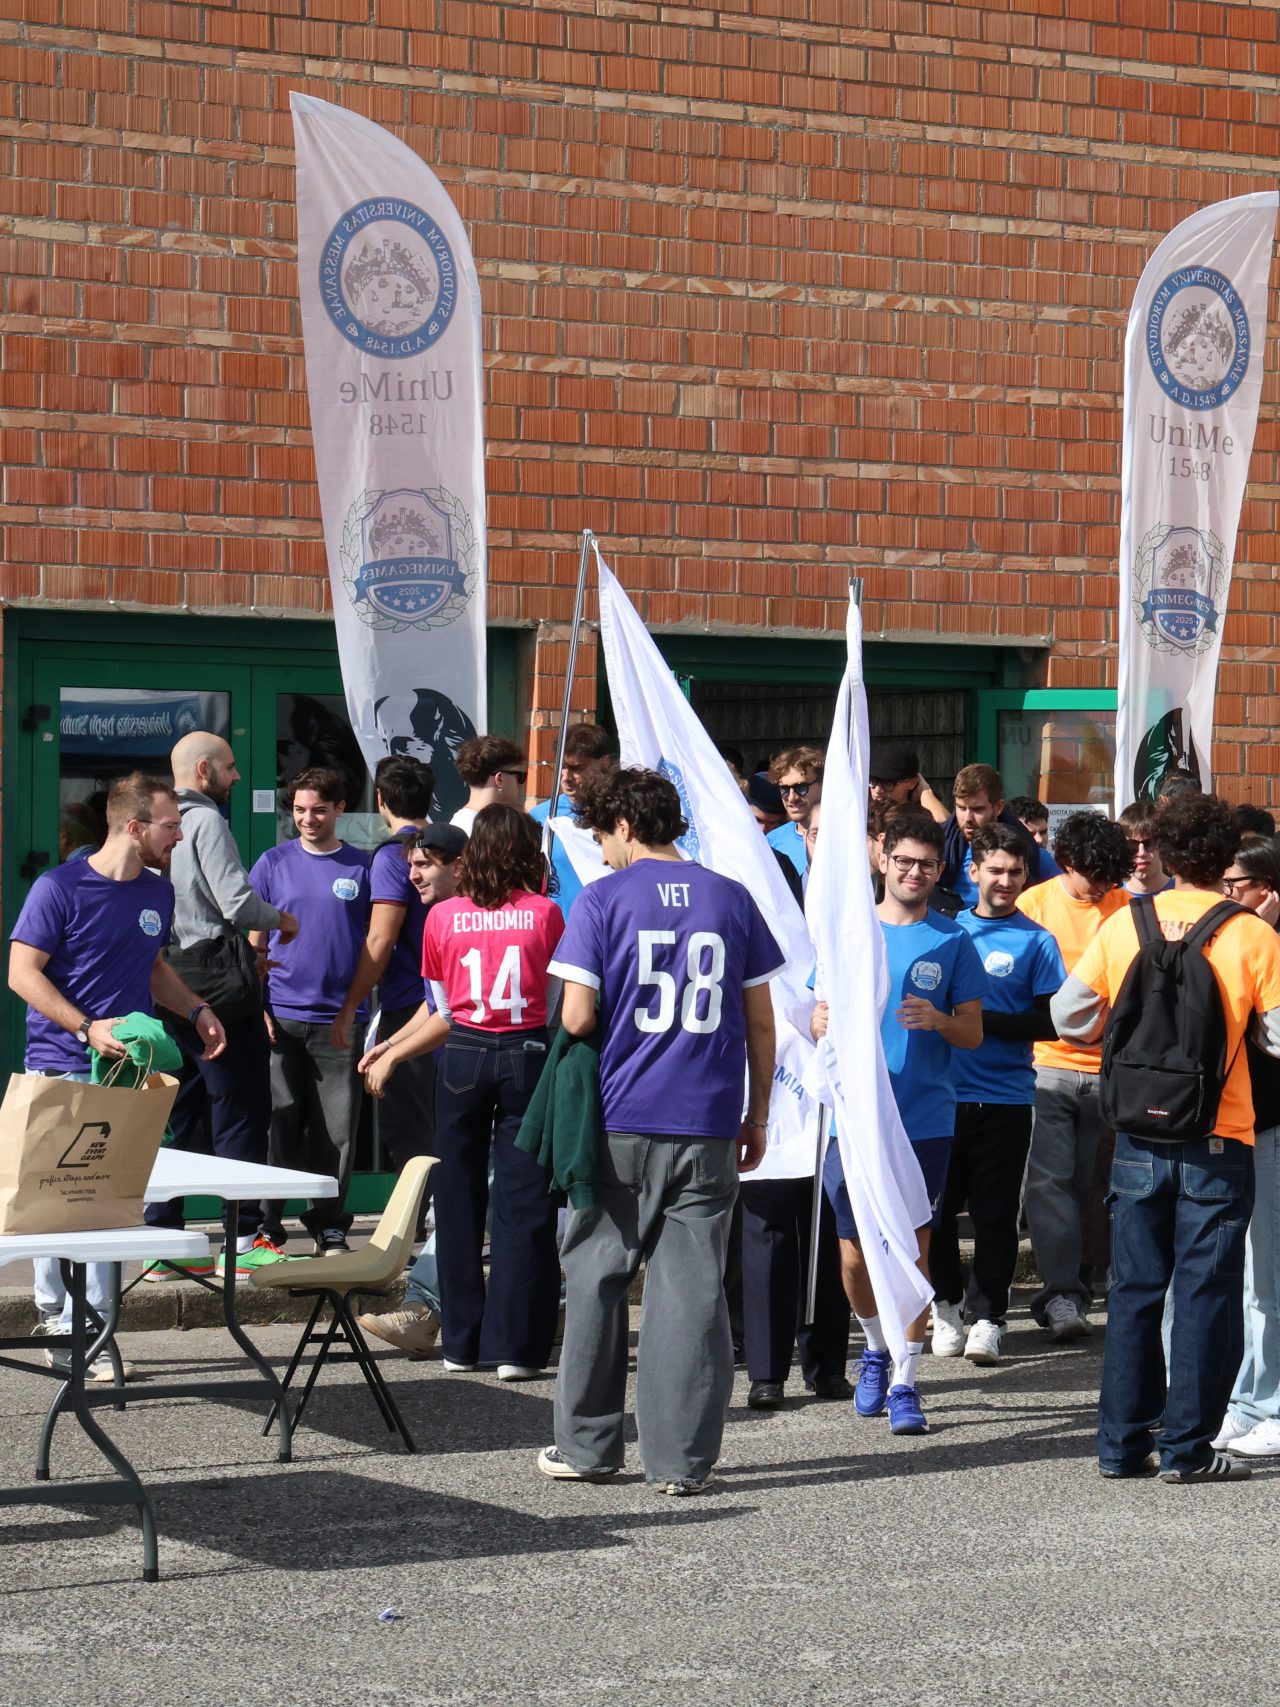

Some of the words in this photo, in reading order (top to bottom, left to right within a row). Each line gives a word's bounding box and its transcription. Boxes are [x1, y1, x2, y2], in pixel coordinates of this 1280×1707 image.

[1150, 414, 1234, 455] UniMe
[1168, 457, 1211, 482] 1548
[656, 883, 690, 907] VET
[453, 910, 534, 934] ECONOMIA
[460, 945, 528, 1024] 14
[633, 930, 726, 1034] 58
